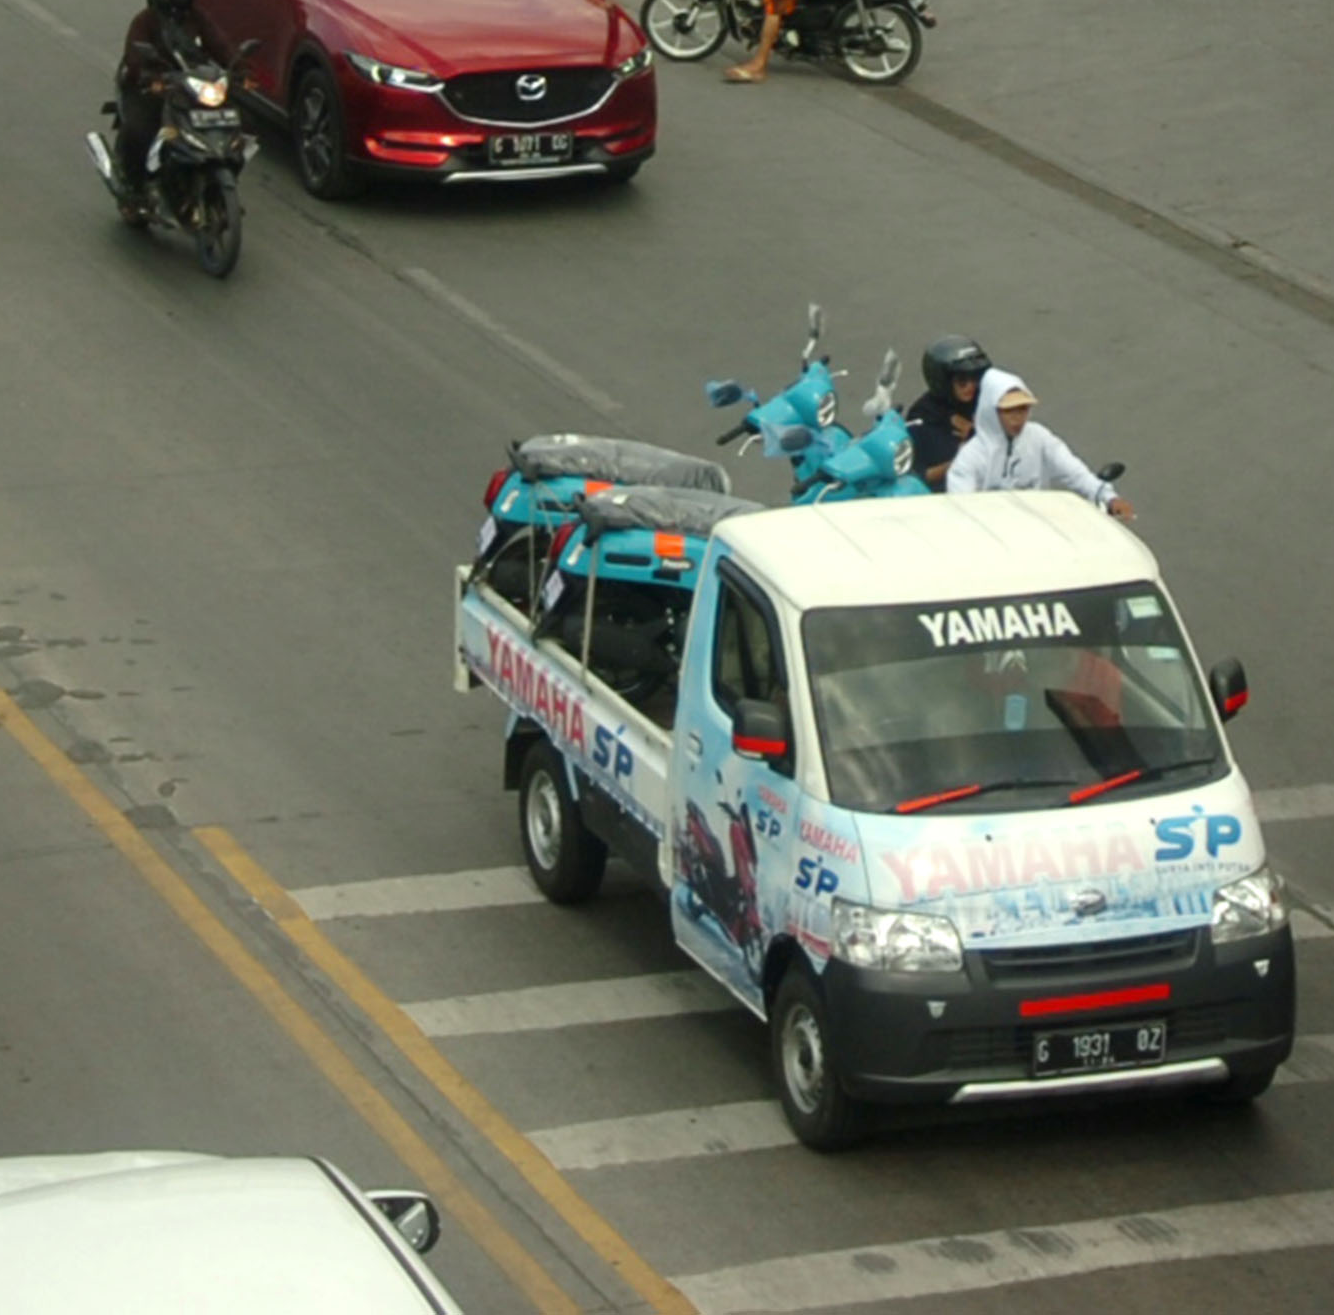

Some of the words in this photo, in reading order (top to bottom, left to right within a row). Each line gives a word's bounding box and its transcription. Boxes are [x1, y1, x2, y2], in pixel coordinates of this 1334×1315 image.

[919, 601, 1082, 649] YAMAHA
[487, 622, 586, 755] YAMAHA
[800, 820, 860, 865] YAMAHA
[880, 834, 1146, 904] YAMAHA
[1038, 1039, 1050, 1063] G
[1072, 1033, 1111, 1059] 1931
